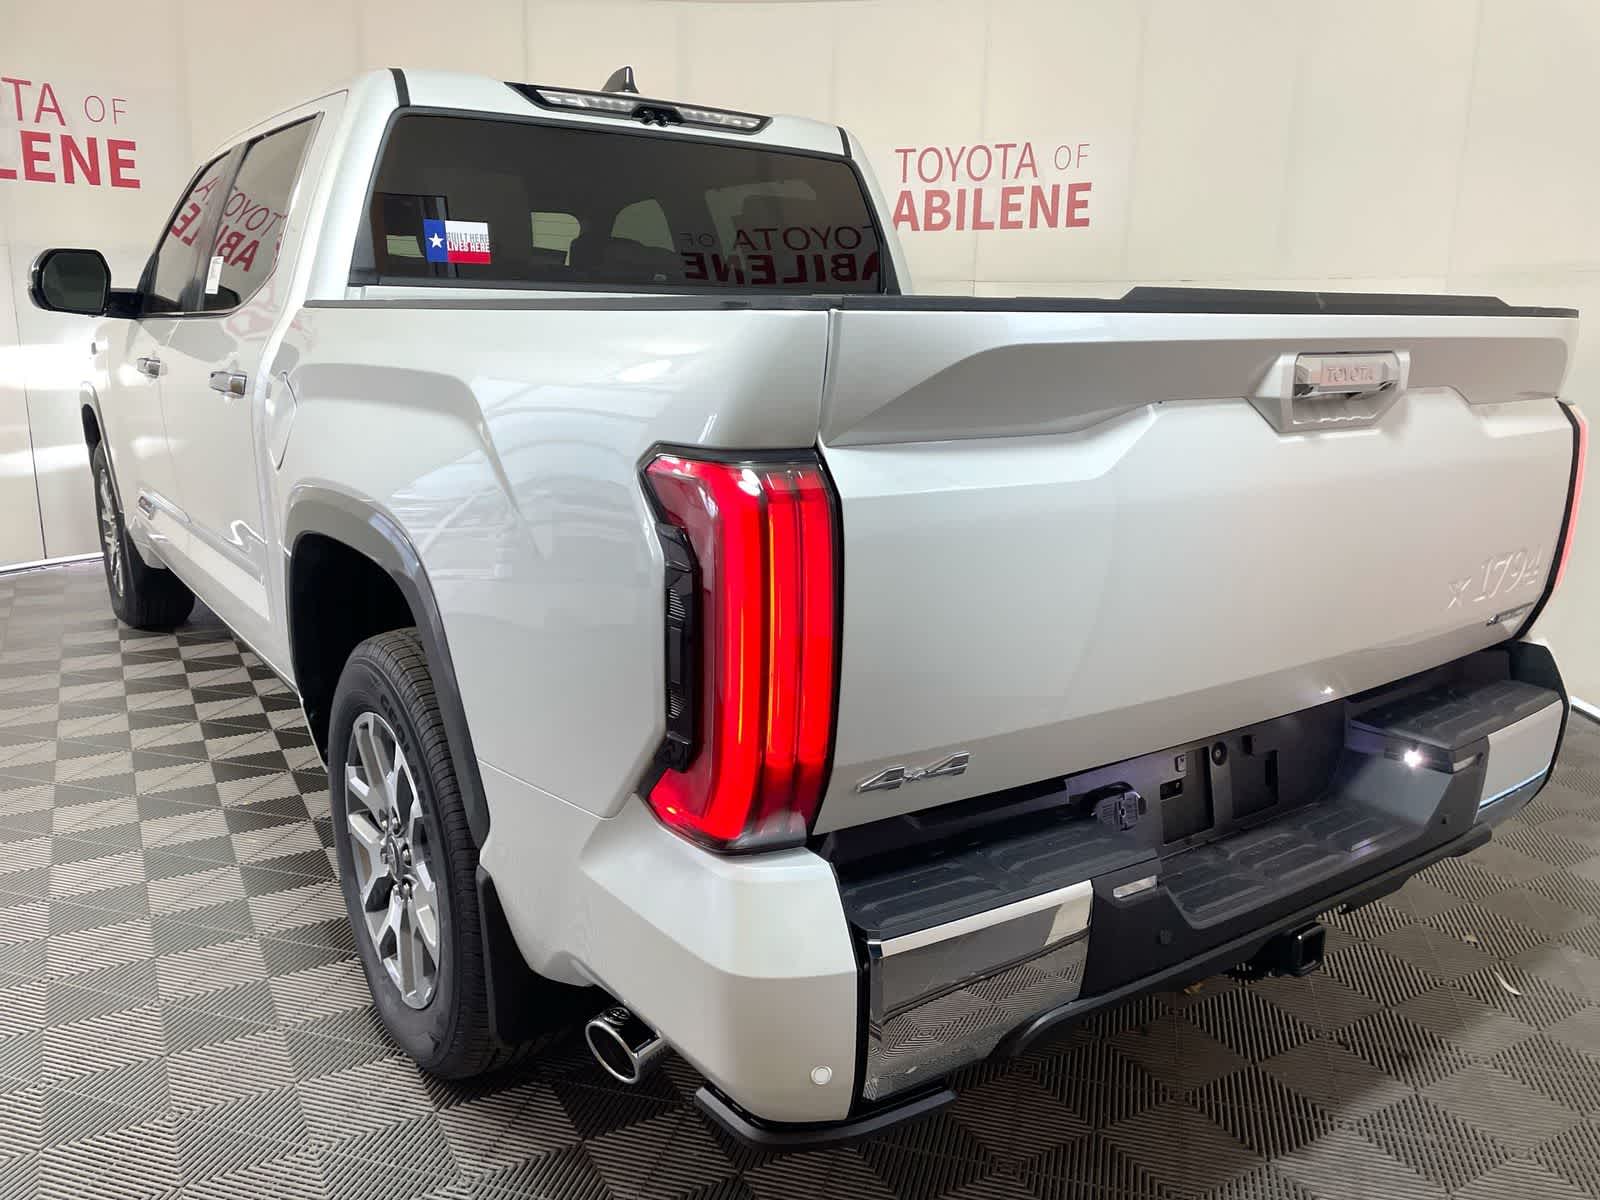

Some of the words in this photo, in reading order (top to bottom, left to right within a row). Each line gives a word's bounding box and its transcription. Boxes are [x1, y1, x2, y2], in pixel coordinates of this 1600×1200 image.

[84, 95, 128, 125] OF
[894, 141, 1039, 183] TOYOTA
[1054, 143, 1091, 171] OF
[892, 182, 1093, 232] ABILENE
[447, 240, 469, 252] LIVES
[470, 241, 490, 253] HERE
[470, 233, 489, 244] HERE
[1326, 366, 1375, 382] TOYOTA
[1473, 545, 1543, 603] 1794
